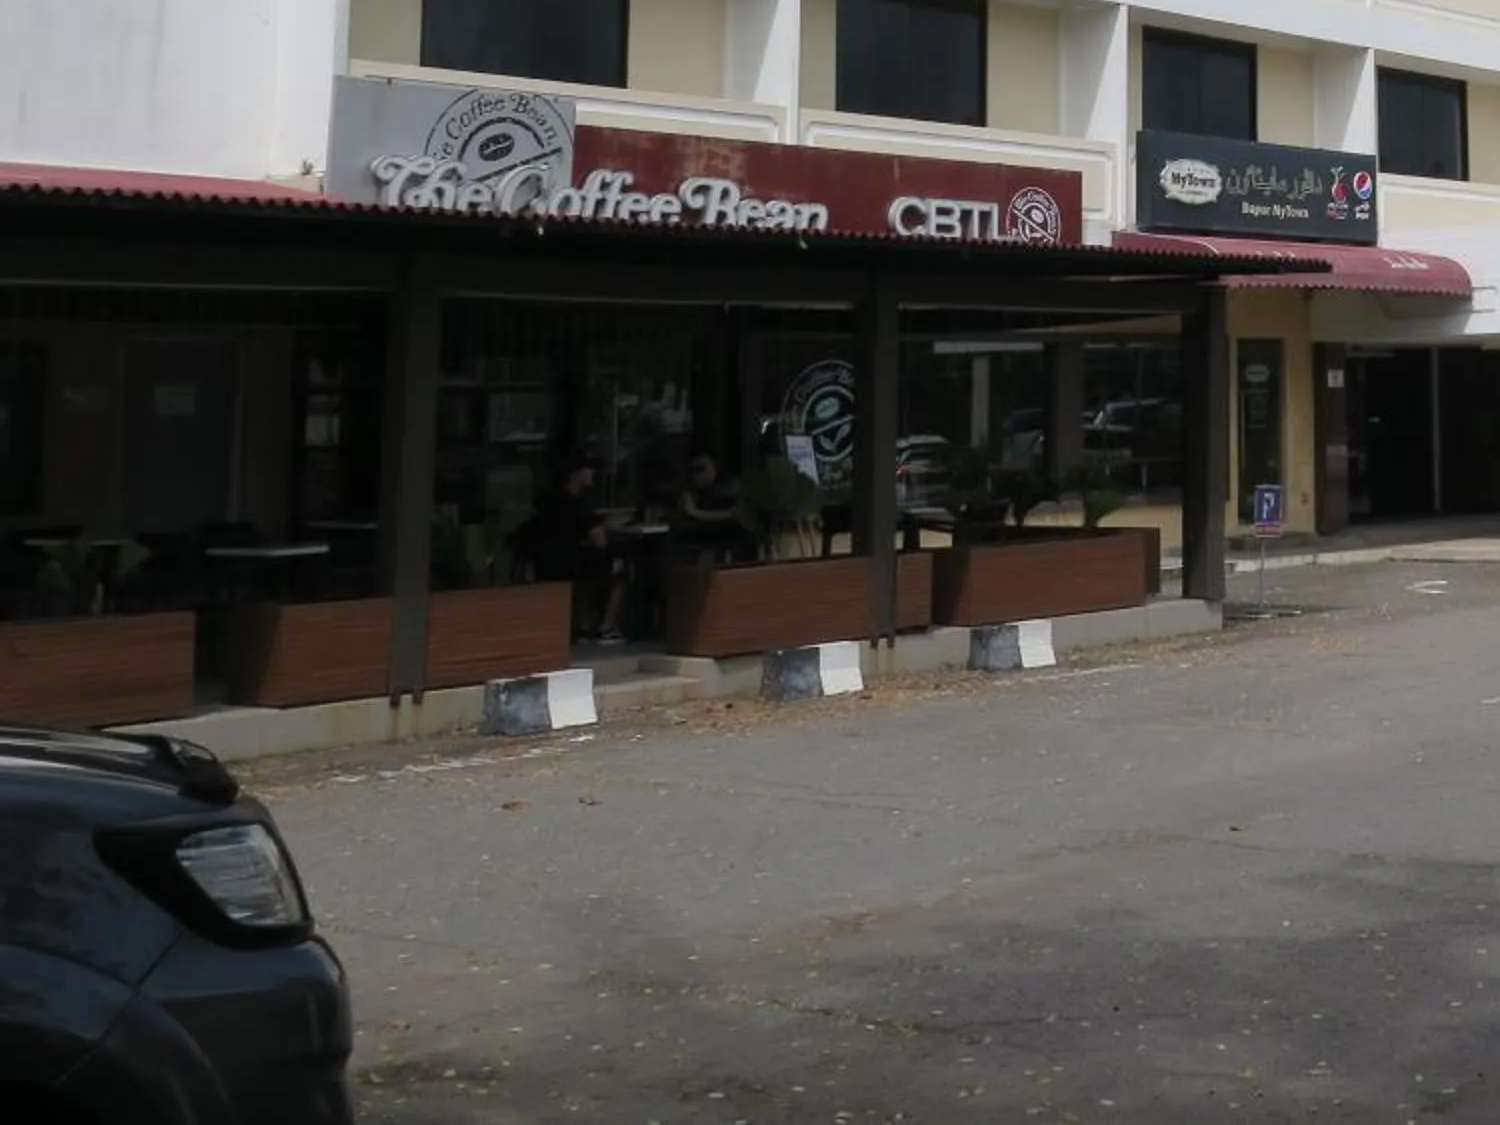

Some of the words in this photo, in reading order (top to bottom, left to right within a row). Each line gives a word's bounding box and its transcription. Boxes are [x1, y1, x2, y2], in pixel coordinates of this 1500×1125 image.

[445, 93, 506, 140] Coffee
[369, 155, 493, 212] The
[499, 164, 683, 223] Coffee
[678, 176, 829, 230] Bean
[1263, 492, 1275, 520] P
